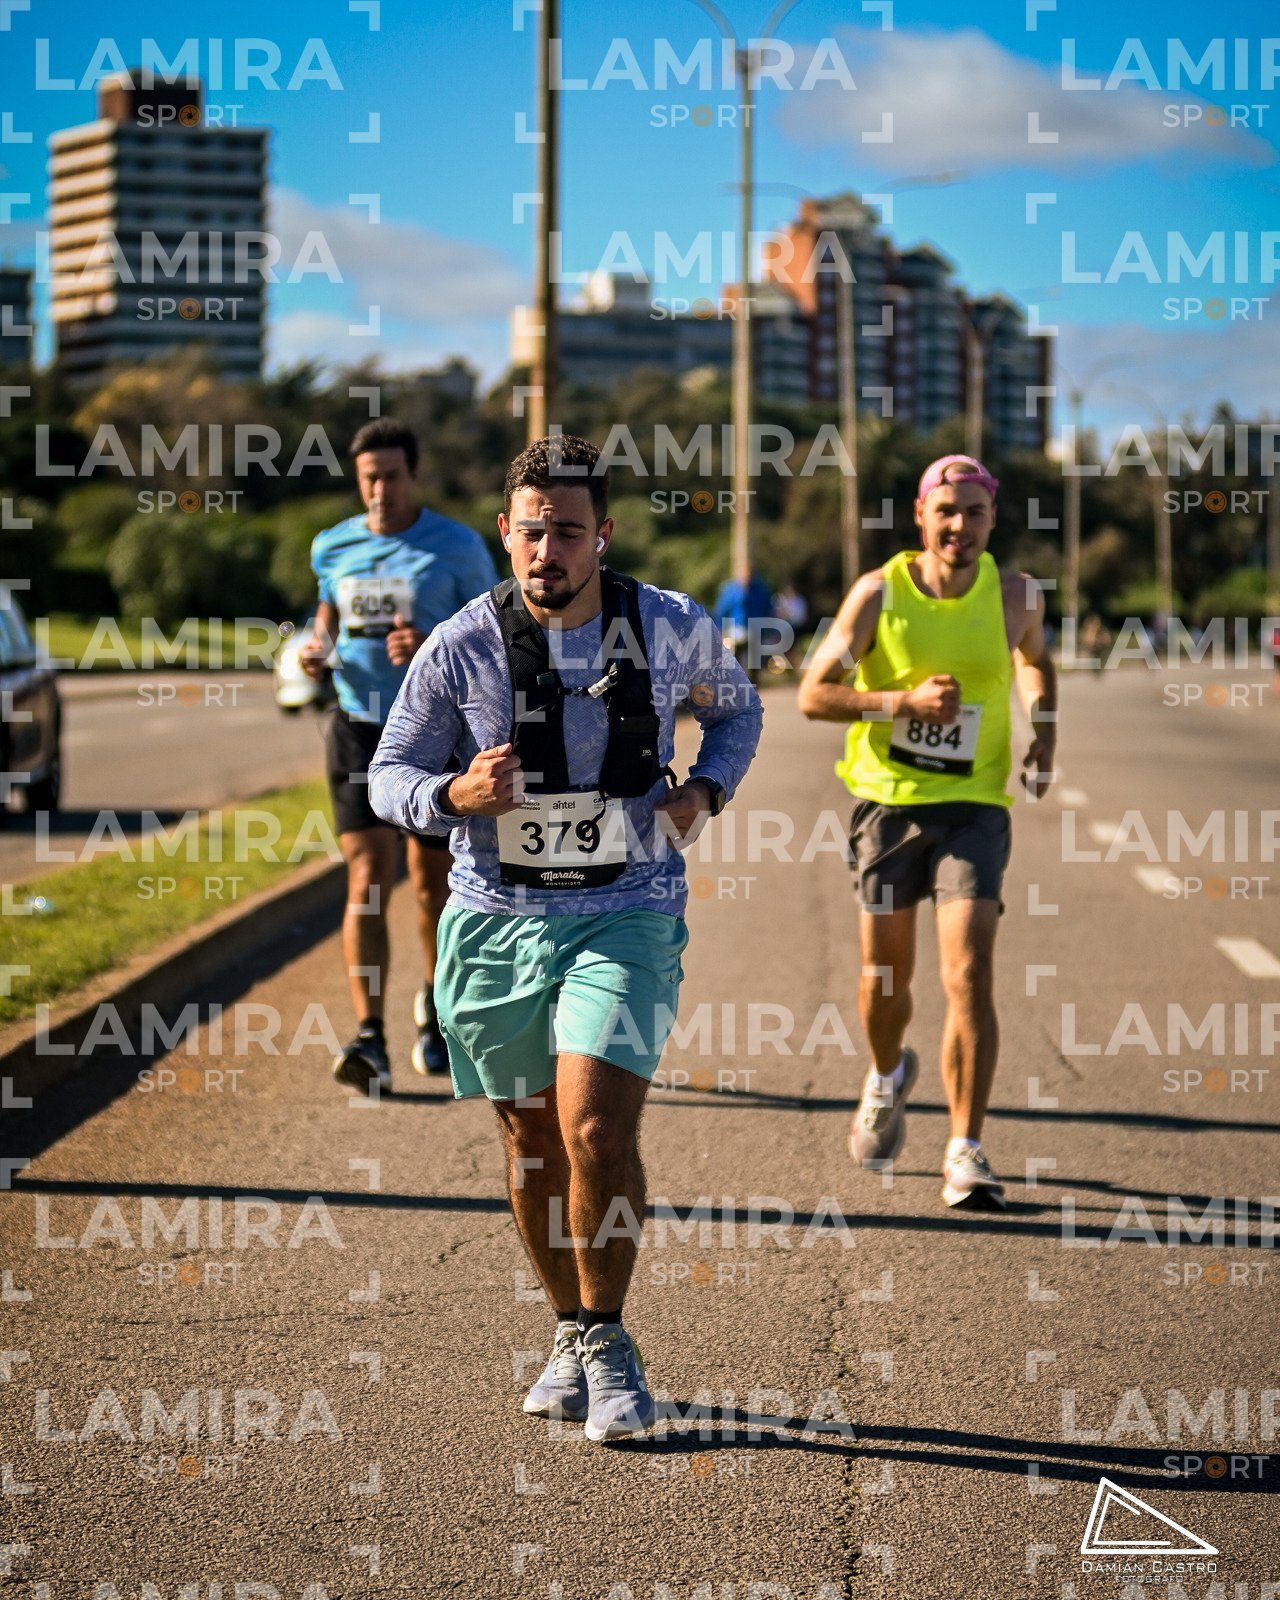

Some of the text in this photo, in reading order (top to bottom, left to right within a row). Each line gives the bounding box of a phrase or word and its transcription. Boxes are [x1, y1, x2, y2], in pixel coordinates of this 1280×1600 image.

[907, 717, 962, 751] 884
[552, 800, 576, 809] antel
[520, 820, 601, 856] 379
[540, 871, 586, 881] Maratón
